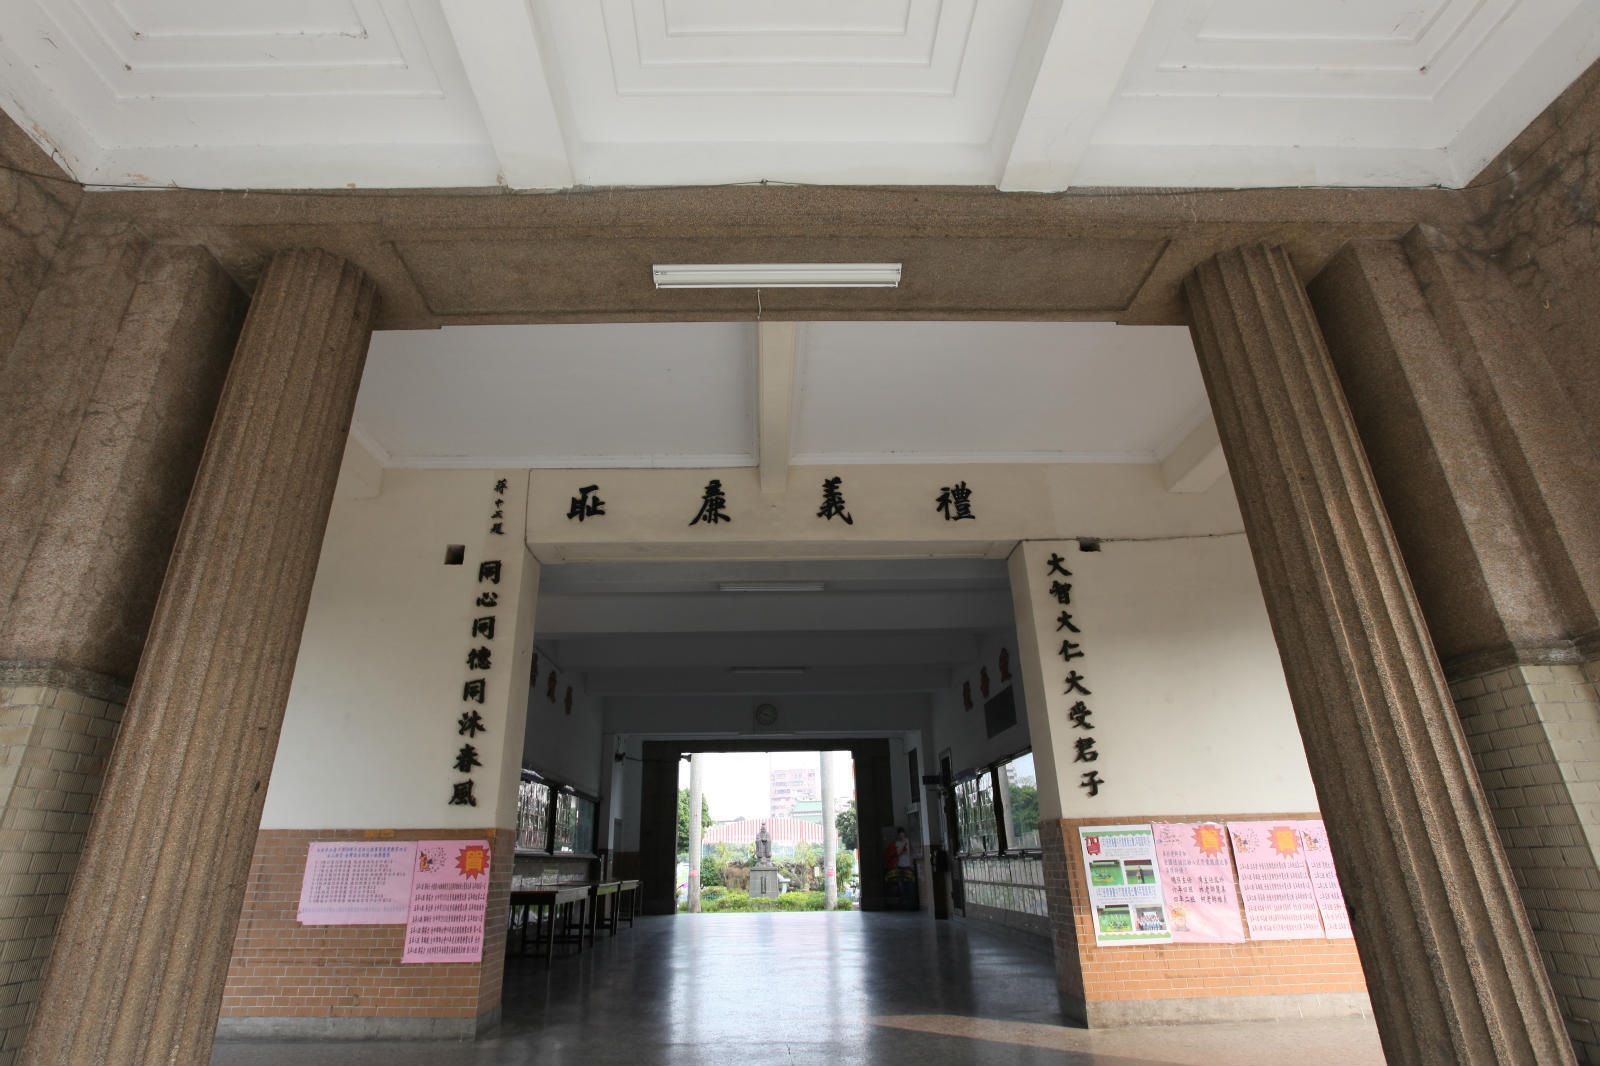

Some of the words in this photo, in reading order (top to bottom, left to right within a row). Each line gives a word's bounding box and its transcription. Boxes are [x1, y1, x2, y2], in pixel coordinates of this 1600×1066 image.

[448, 560, 502, 808] 同心同德同沐春風
[1047, 552, 1105, 797] 大智大仁大受君子
